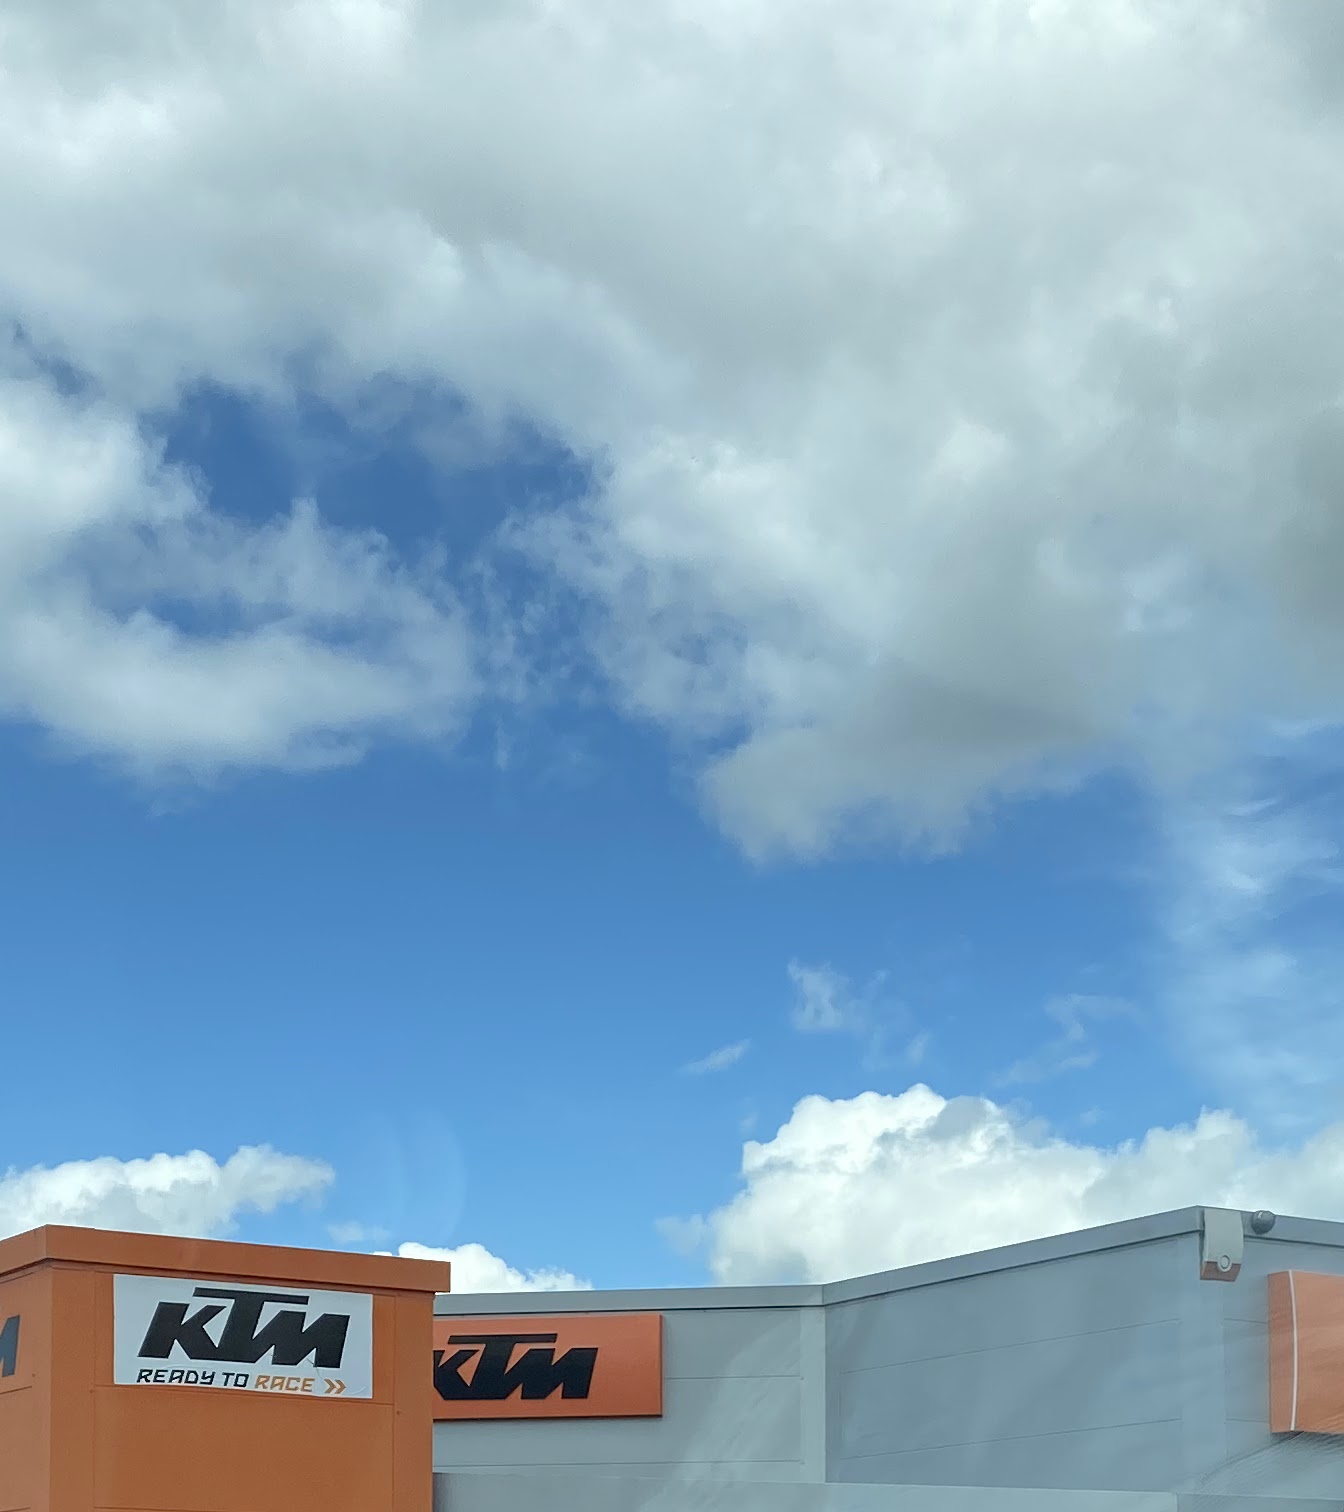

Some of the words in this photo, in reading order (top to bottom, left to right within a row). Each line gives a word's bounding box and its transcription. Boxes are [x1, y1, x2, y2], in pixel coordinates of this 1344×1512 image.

[137, 1286, 351, 1369] KTM
[136, 1368, 216, 1386] READY
[221, 1371, 250, 1388] TO
[255, 1374, 316, 1393] RACE
[433, 1333, 599, 1401] KTM
